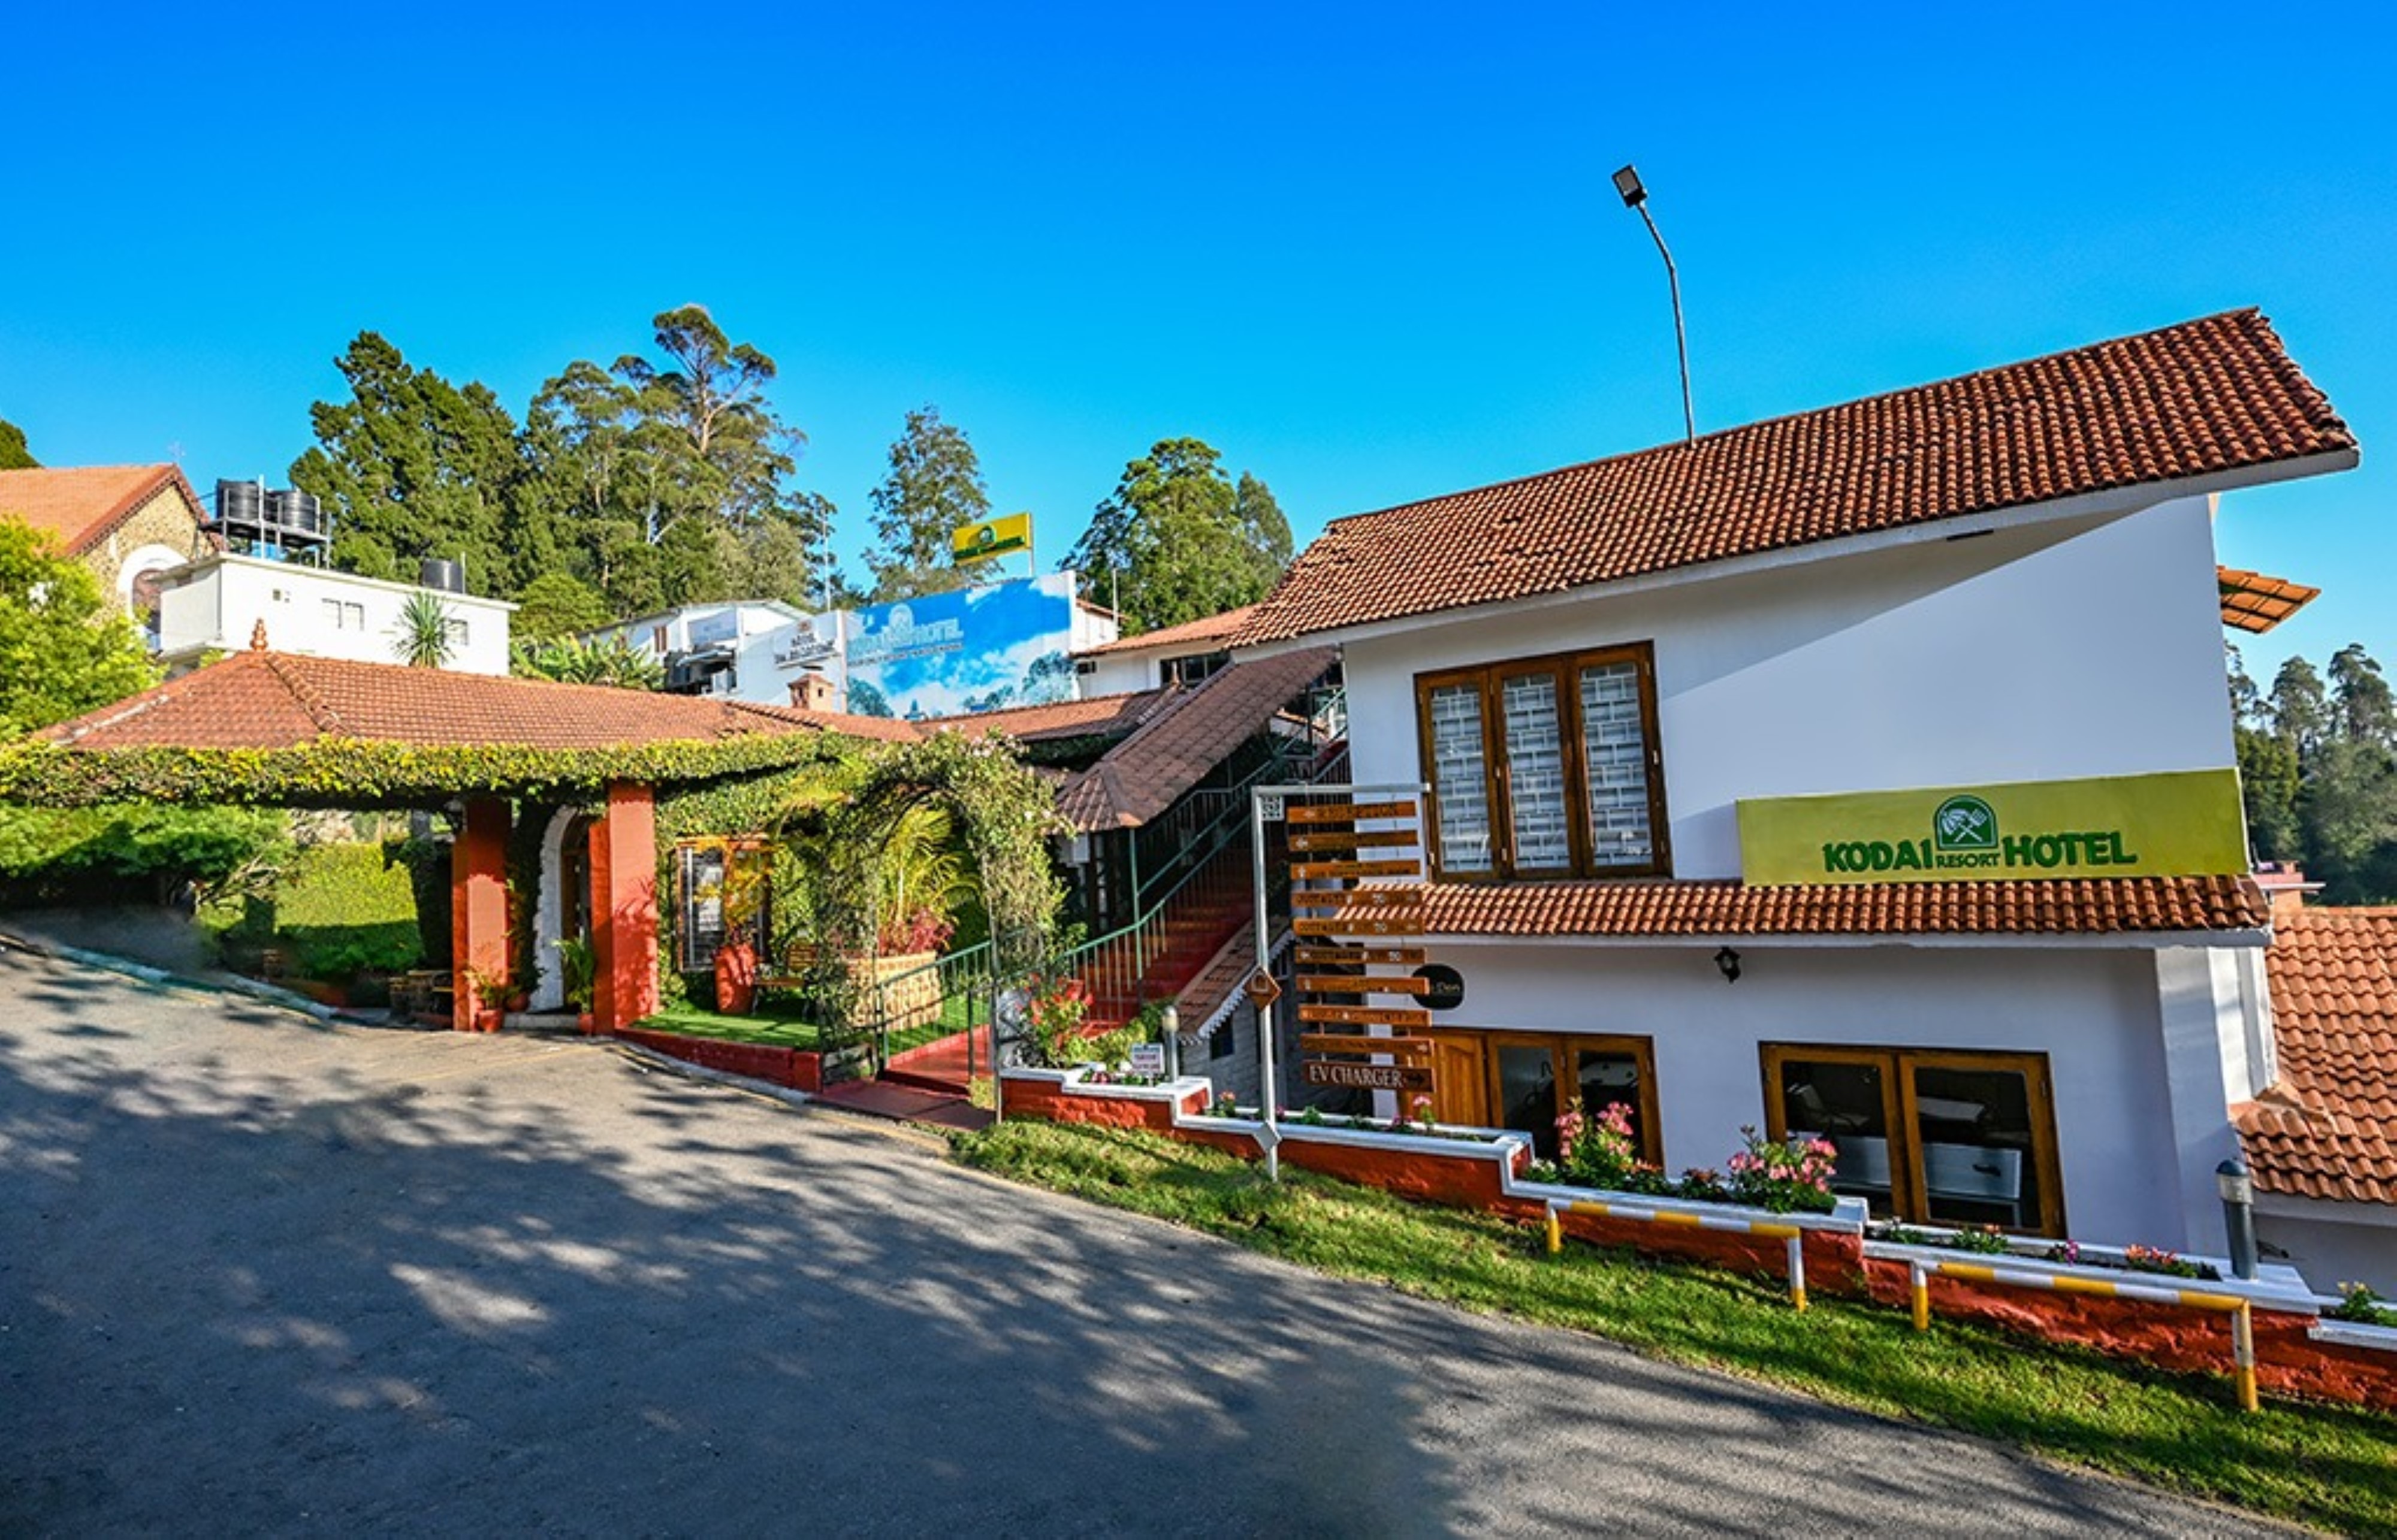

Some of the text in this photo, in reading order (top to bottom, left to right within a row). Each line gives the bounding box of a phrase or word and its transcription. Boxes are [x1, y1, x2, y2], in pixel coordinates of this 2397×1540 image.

[1822, 831, 2138, 872] KODAI RESORT HOTEL
[1309, 1064, 1404, 1088] EV CHARGER
